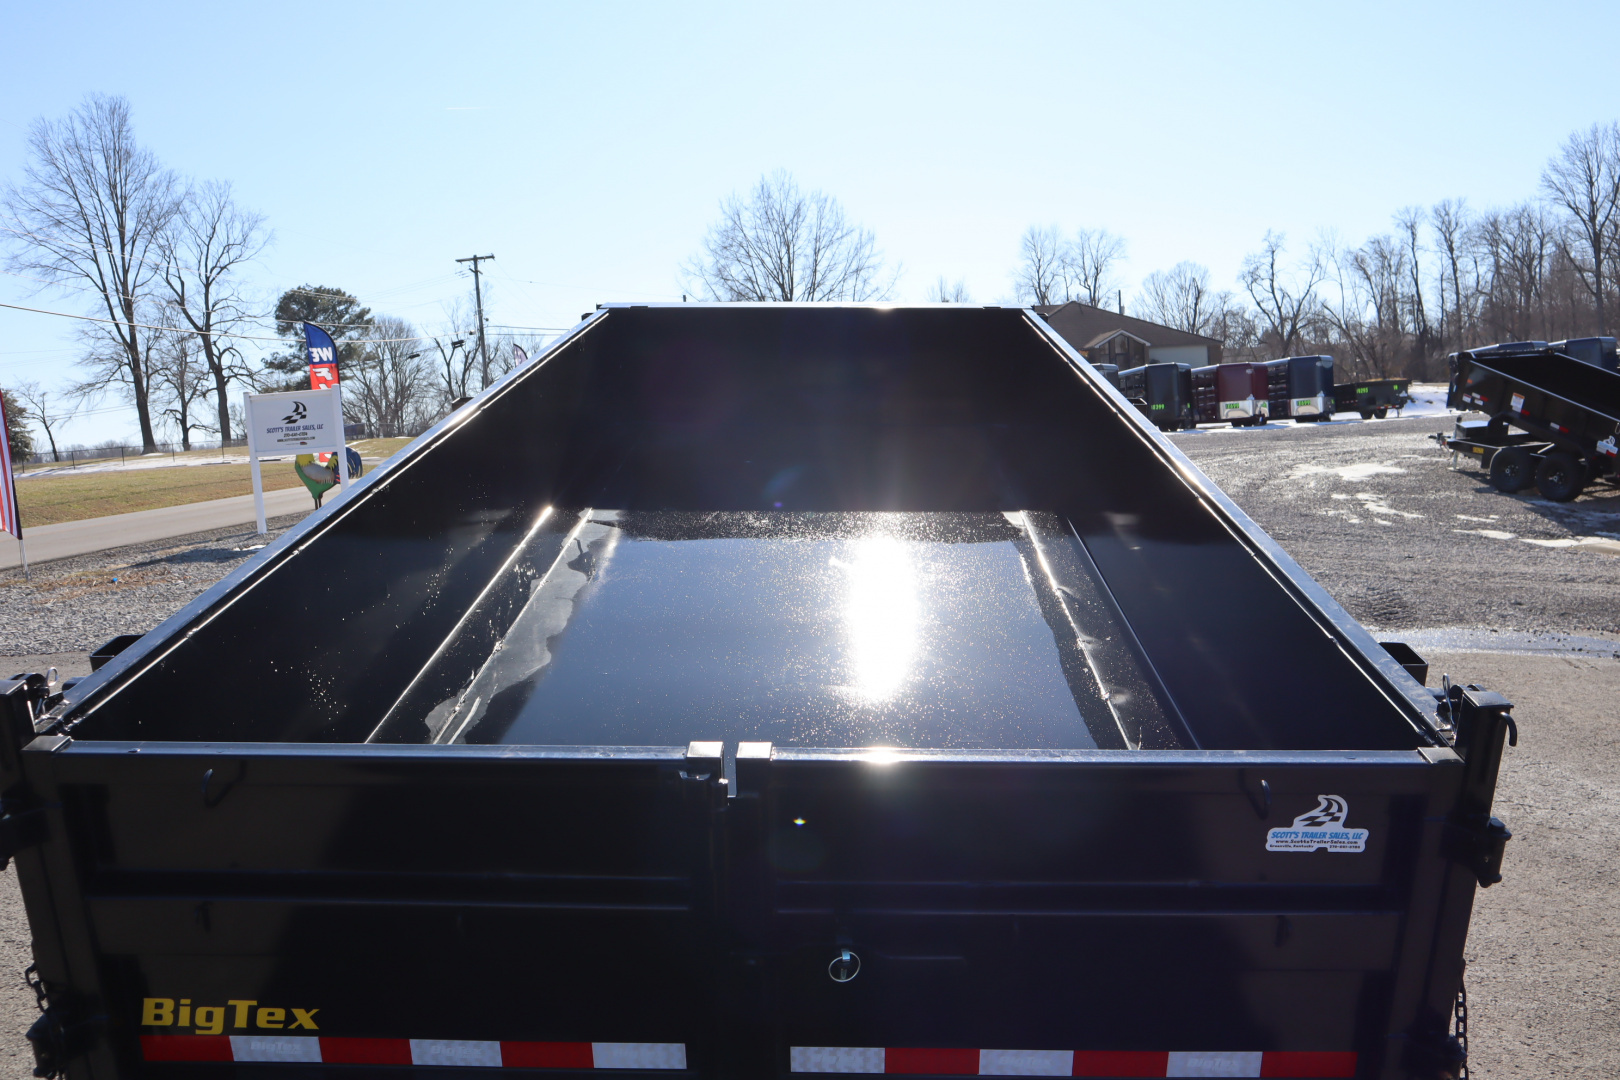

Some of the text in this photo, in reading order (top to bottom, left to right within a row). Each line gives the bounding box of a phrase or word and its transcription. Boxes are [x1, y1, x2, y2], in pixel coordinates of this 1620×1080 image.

[1271, 831, 1364, 840] SCOTT'S TRAILER SALES, LLC
[141, 997, 320, 1035] BigTex
